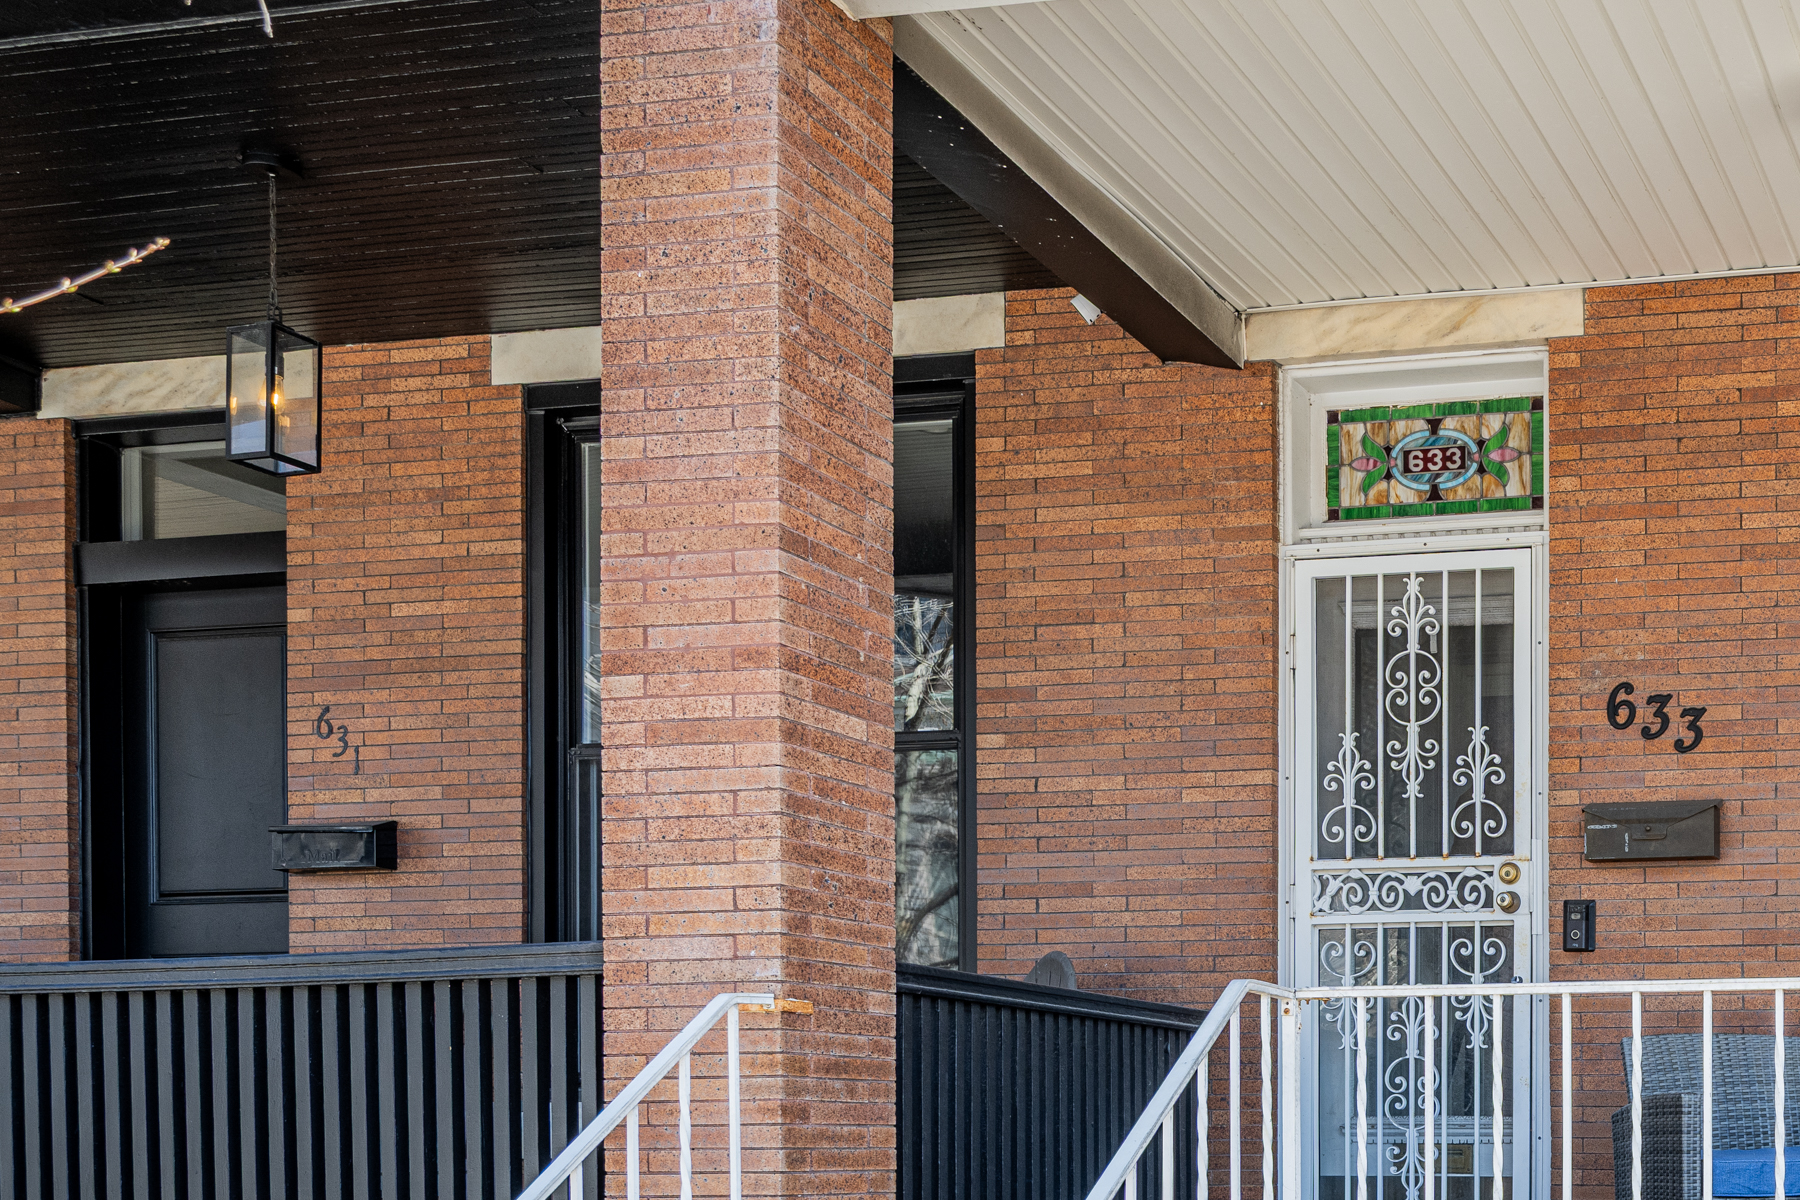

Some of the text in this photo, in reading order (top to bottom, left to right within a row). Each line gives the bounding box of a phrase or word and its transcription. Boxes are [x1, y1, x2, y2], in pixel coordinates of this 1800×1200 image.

[1408, 447, 1461, 472] 633
[316, 705, 360, 775] 631
[1606, 681, 1708, 753] 633
[305, 848, 341, 862] Mail
